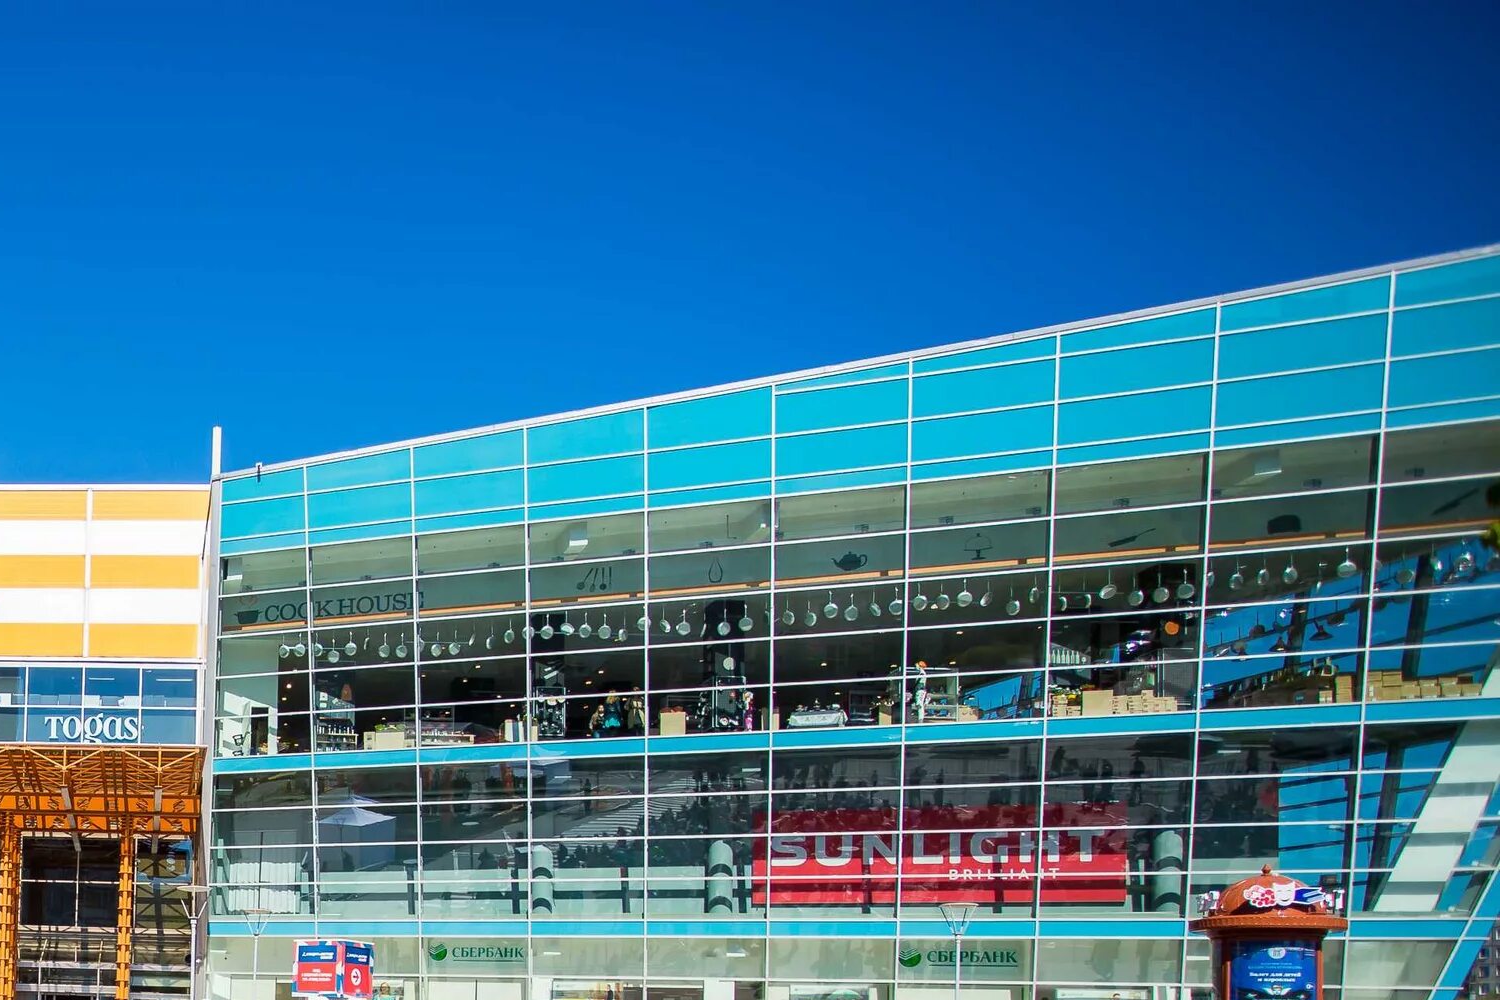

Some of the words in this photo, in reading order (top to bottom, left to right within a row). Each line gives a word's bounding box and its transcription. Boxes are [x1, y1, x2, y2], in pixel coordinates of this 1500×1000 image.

[770, 829, 1105, 867] SUNLIGHT
[948, 867, 1060, 880] BRILLIANT
[452, 946, 524, 958] СБЕРБАНК
[927, 950, 1017, 963] СБЕРБАНК
